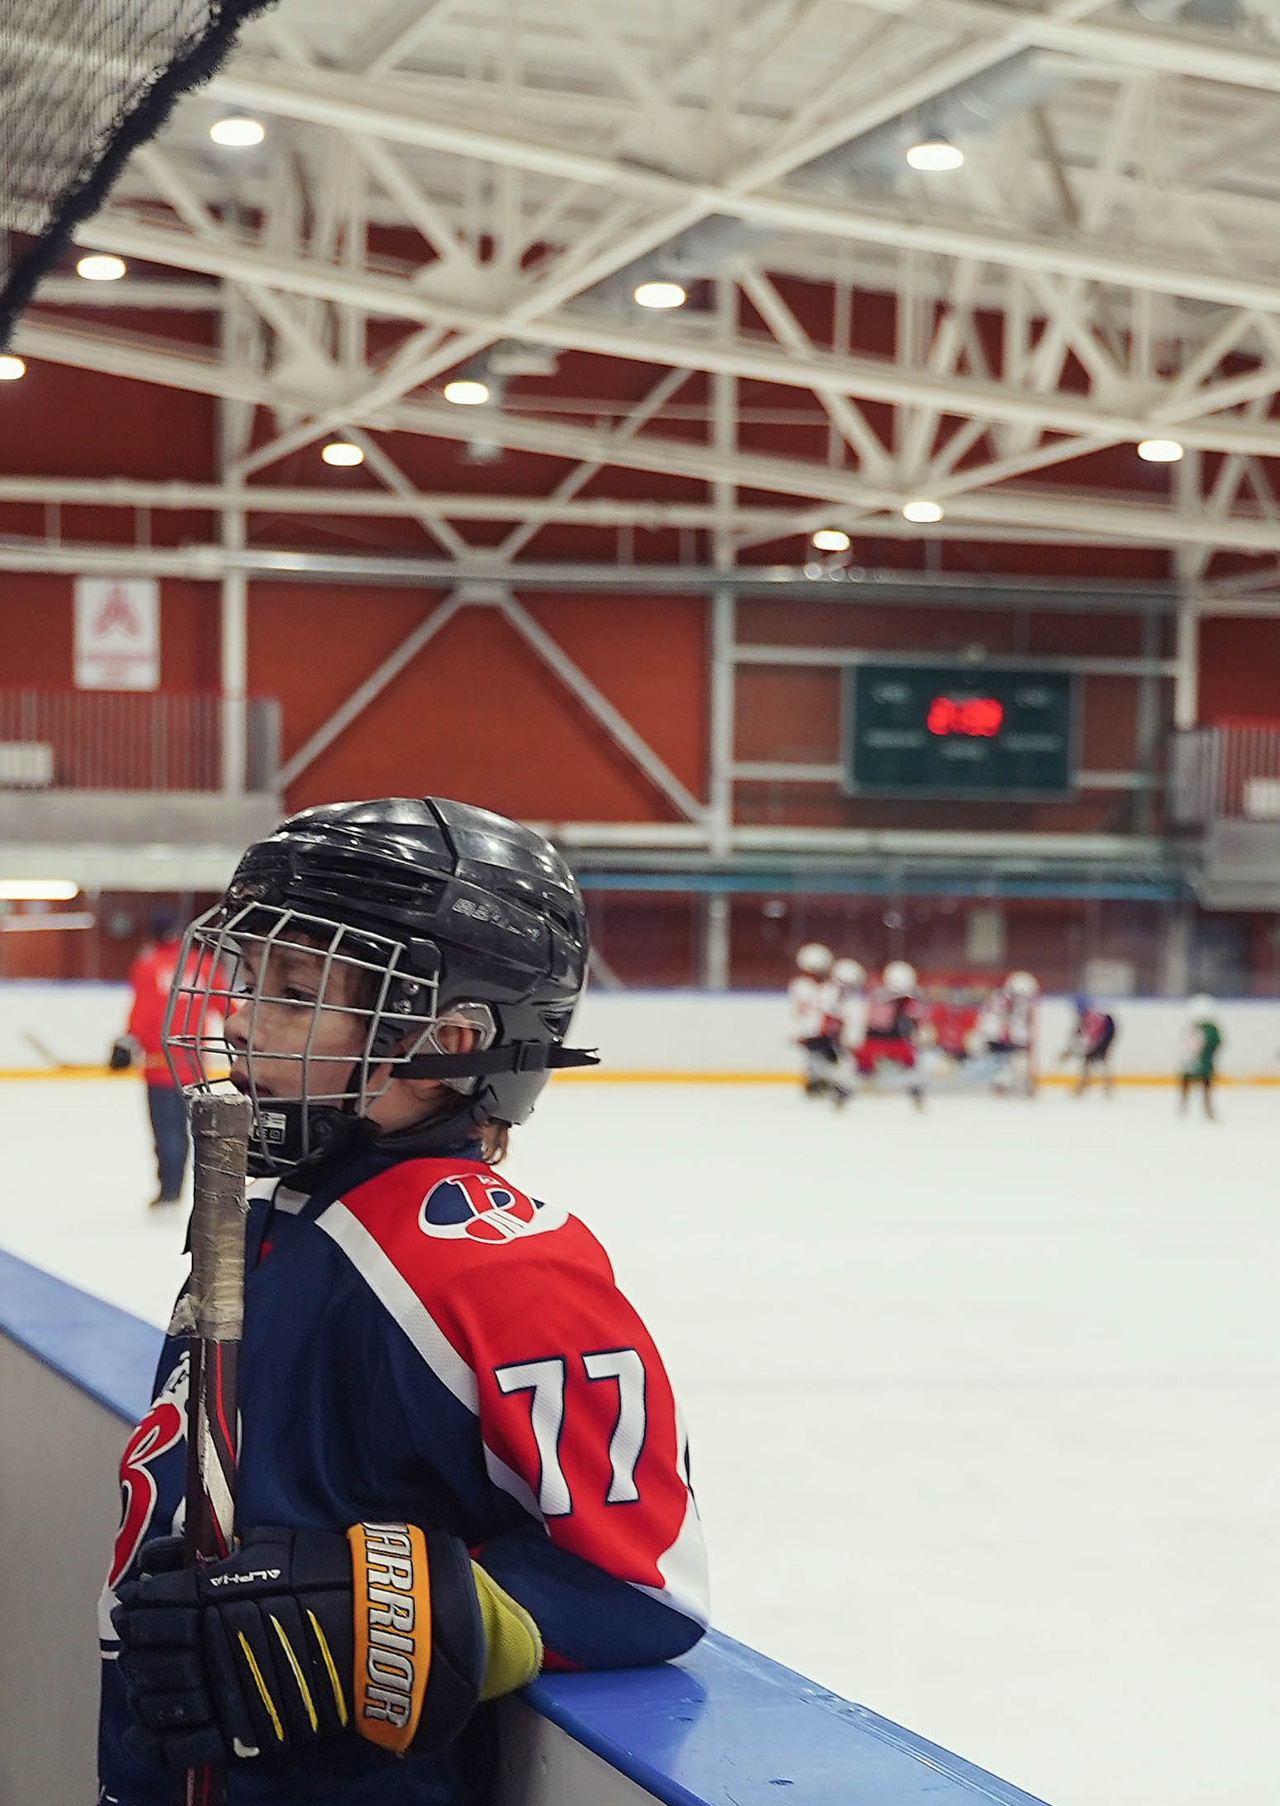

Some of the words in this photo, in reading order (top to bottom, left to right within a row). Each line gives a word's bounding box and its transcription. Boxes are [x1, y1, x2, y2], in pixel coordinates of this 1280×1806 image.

[492, 1346, 648, 1518] 77
[209, 1568, 282, 1588] ALPHA
[362, 1521, 418, 1729] ARRIOR
